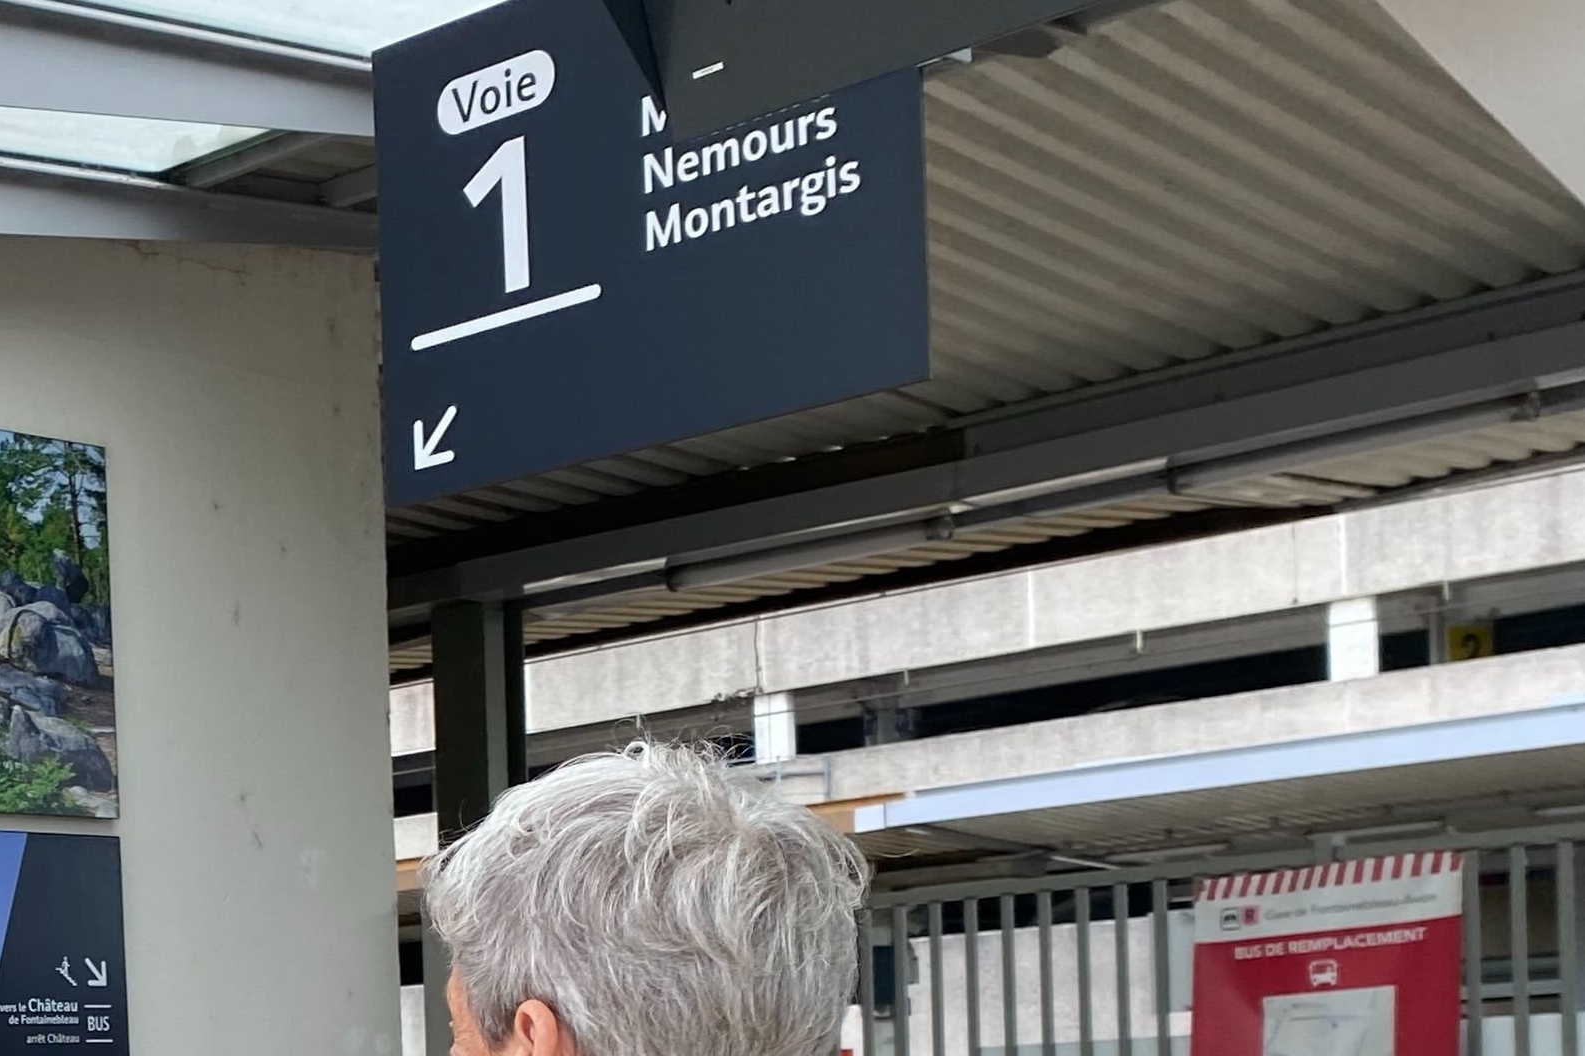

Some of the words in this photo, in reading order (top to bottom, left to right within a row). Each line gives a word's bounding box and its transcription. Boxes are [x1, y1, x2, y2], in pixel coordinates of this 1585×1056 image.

[451, 69, 537, 124] Voie
[643, 106, 838, 194] Nemours
[463, 135, 530, 294] 1
[644, 157, 862, 252] Montargis
[1234, 945, 1261, 960] BUS
[1265, 943, 1286, 957] DE
[1288, 926, 1428, 953] REMPLACEMENT
[0, 1004, 17, 1012] vers
[18, 1002, 27, 1012] le
[28, 998, 79, 1012] Château
[8, 1014, 19, 1025] de
[21, 1014, 79, 1025] Fontainebleau
[26, 1033, 46, 1044] arrêt
[47, 1033, 80, 1044] Château
[87, 1016, 110, 1031] BUS
